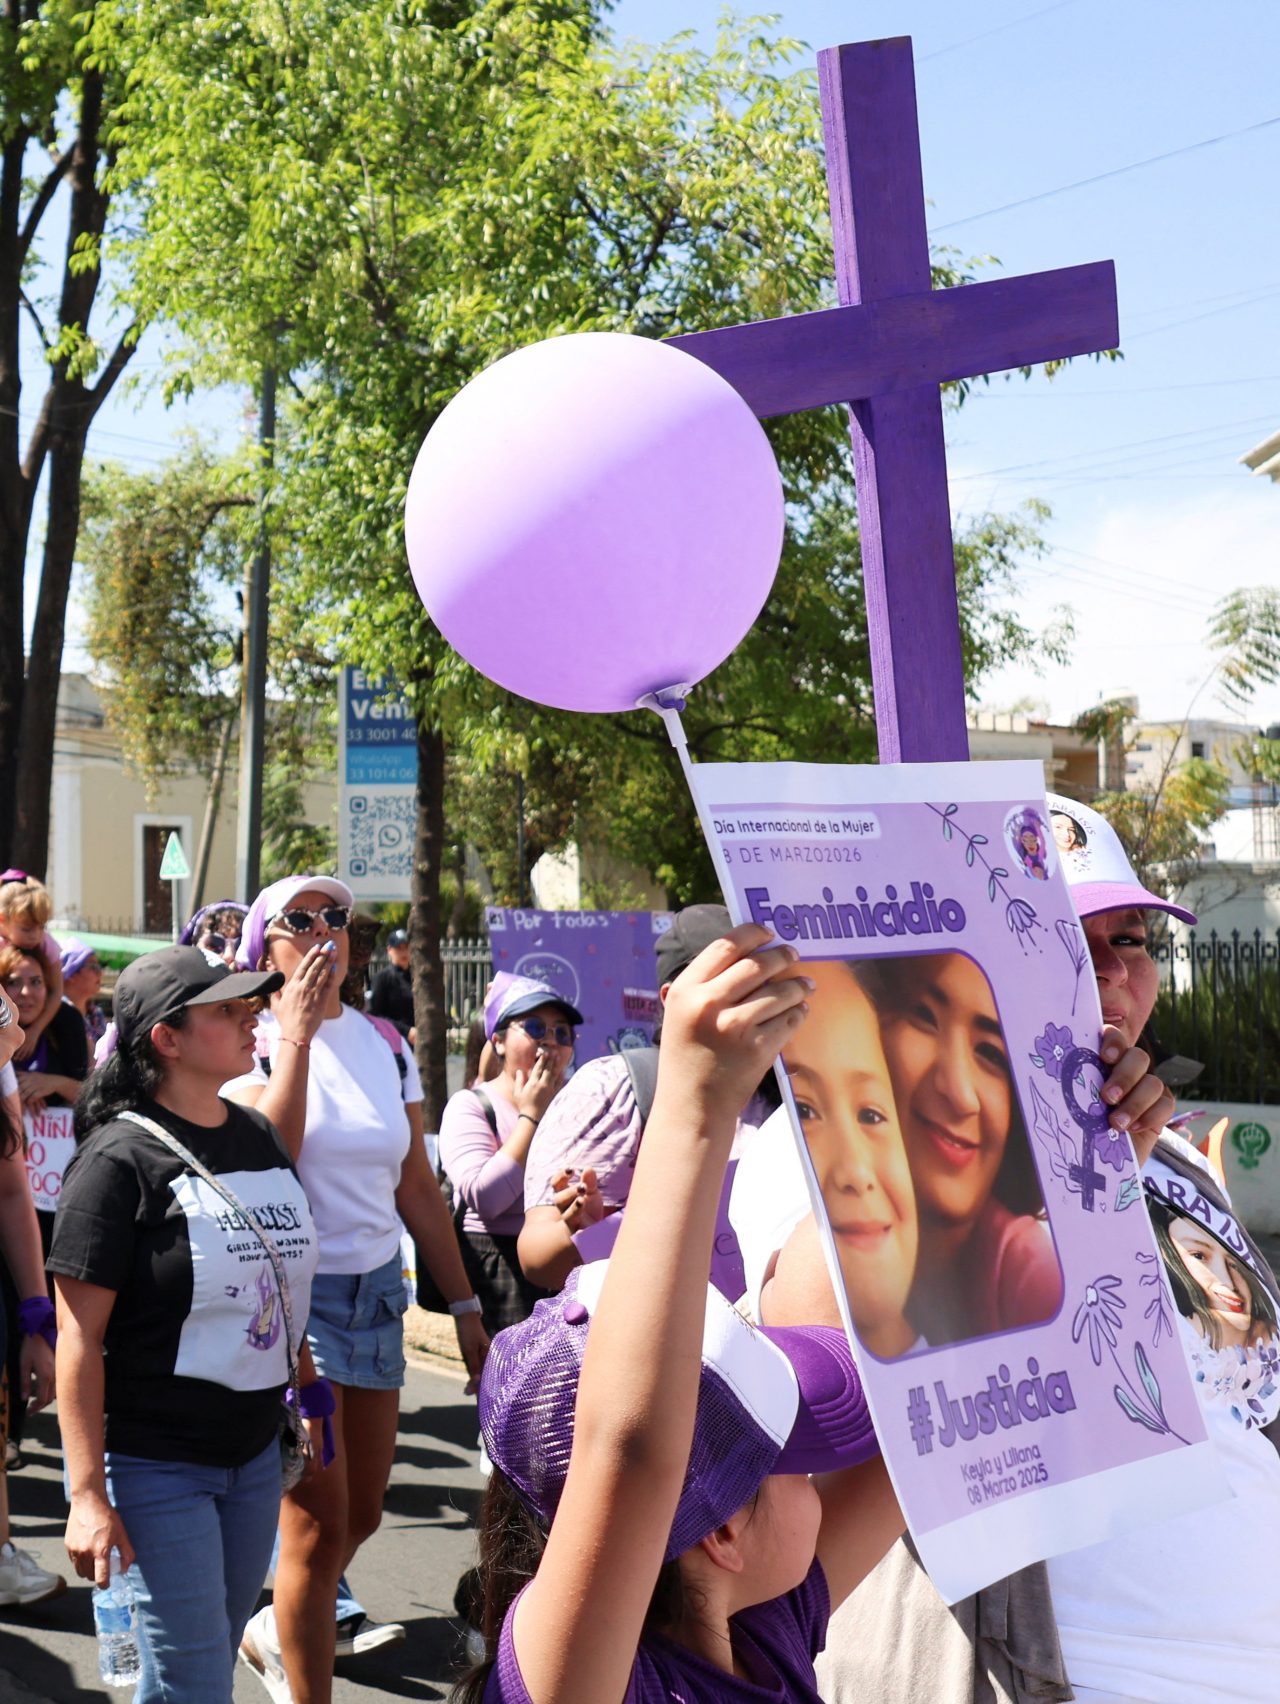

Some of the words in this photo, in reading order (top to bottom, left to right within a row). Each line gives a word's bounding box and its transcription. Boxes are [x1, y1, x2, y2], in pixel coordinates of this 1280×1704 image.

[367, 728, 397, 741] 3001
[1047, 801, 1077, 818] ARA
[713, 820, 735, 834] Día
[737, 819, 812, 834] Internacional
[814, 820, 828, 834] de
[828, 820, 840, 833] la
[842, 820, 875, 836] Mujer
[739, 848, 763, 863] DE
[770, 846, 862, 863] MARZO2026
[744, 881, 967, 941] Feminicidio
[1144, 1176, 1211, 1224] ARA
[907, 1356, 1077, 1456] #Justicia
[960, 1456, 993, 1483] Keyla
[993, 1456, 1003, 1476] y
[967, 1484, 982, 1506] 08
[981, 1476, 1017, 1501] Marzo
[1017, 1462, 1049, 1488] 2025
